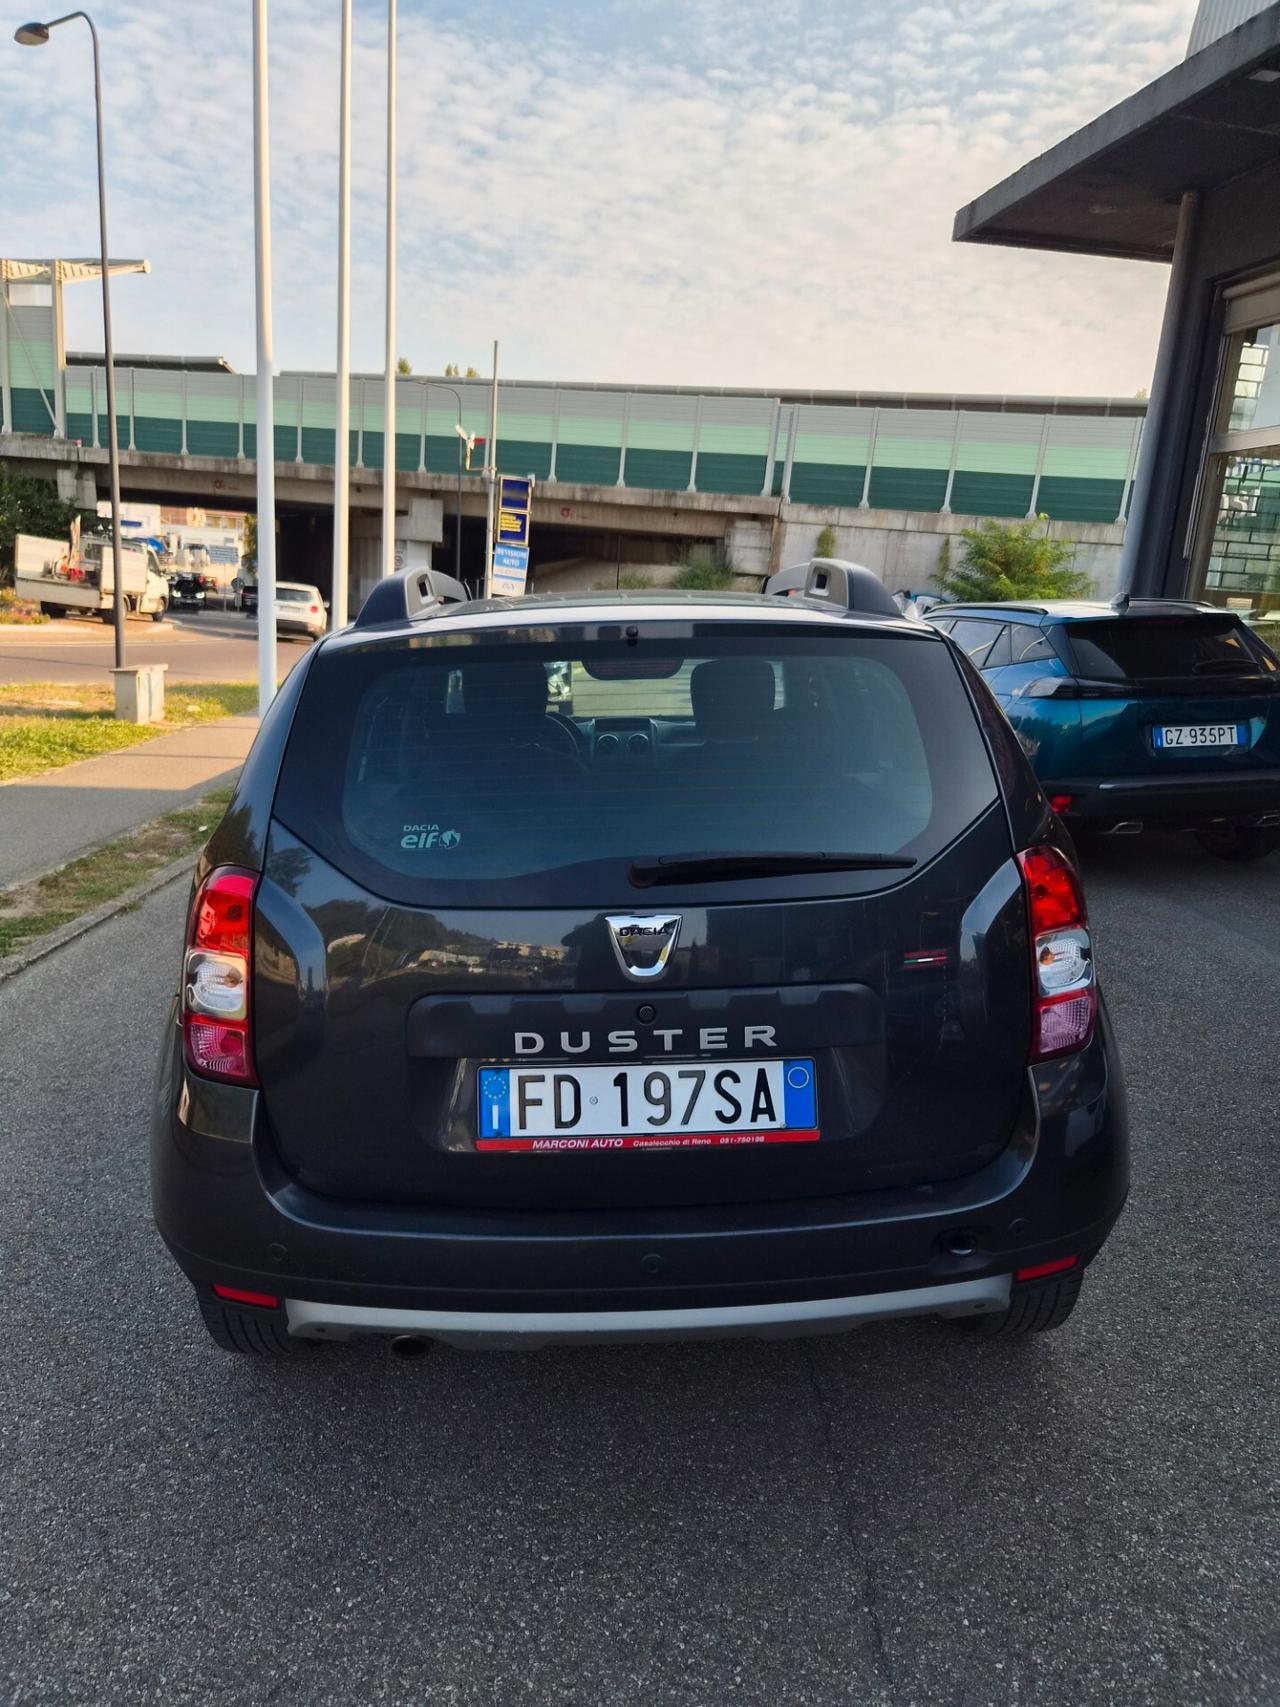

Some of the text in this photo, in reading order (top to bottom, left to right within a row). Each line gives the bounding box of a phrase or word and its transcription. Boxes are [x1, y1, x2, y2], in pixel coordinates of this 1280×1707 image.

[1165, 726, 1235, 745] GZ 935PT
[403, 824, 440, 832] DACIA
[400, 832, 439, 849] elf
[620, 926, 669, 936] DACIA
[514, 1025, 777, 1054] DUSTER
[518, 1067, 777, 1130] FD 197SA
[532, 1139, 589, 1149] MARCONI
[591, 1138, 624, 1148] AUTO
[633, 1138, 681, 1148] Casalecchio
[682, 1138, 690, 1146] di
[692, 1137, 712, 1145] Reno
